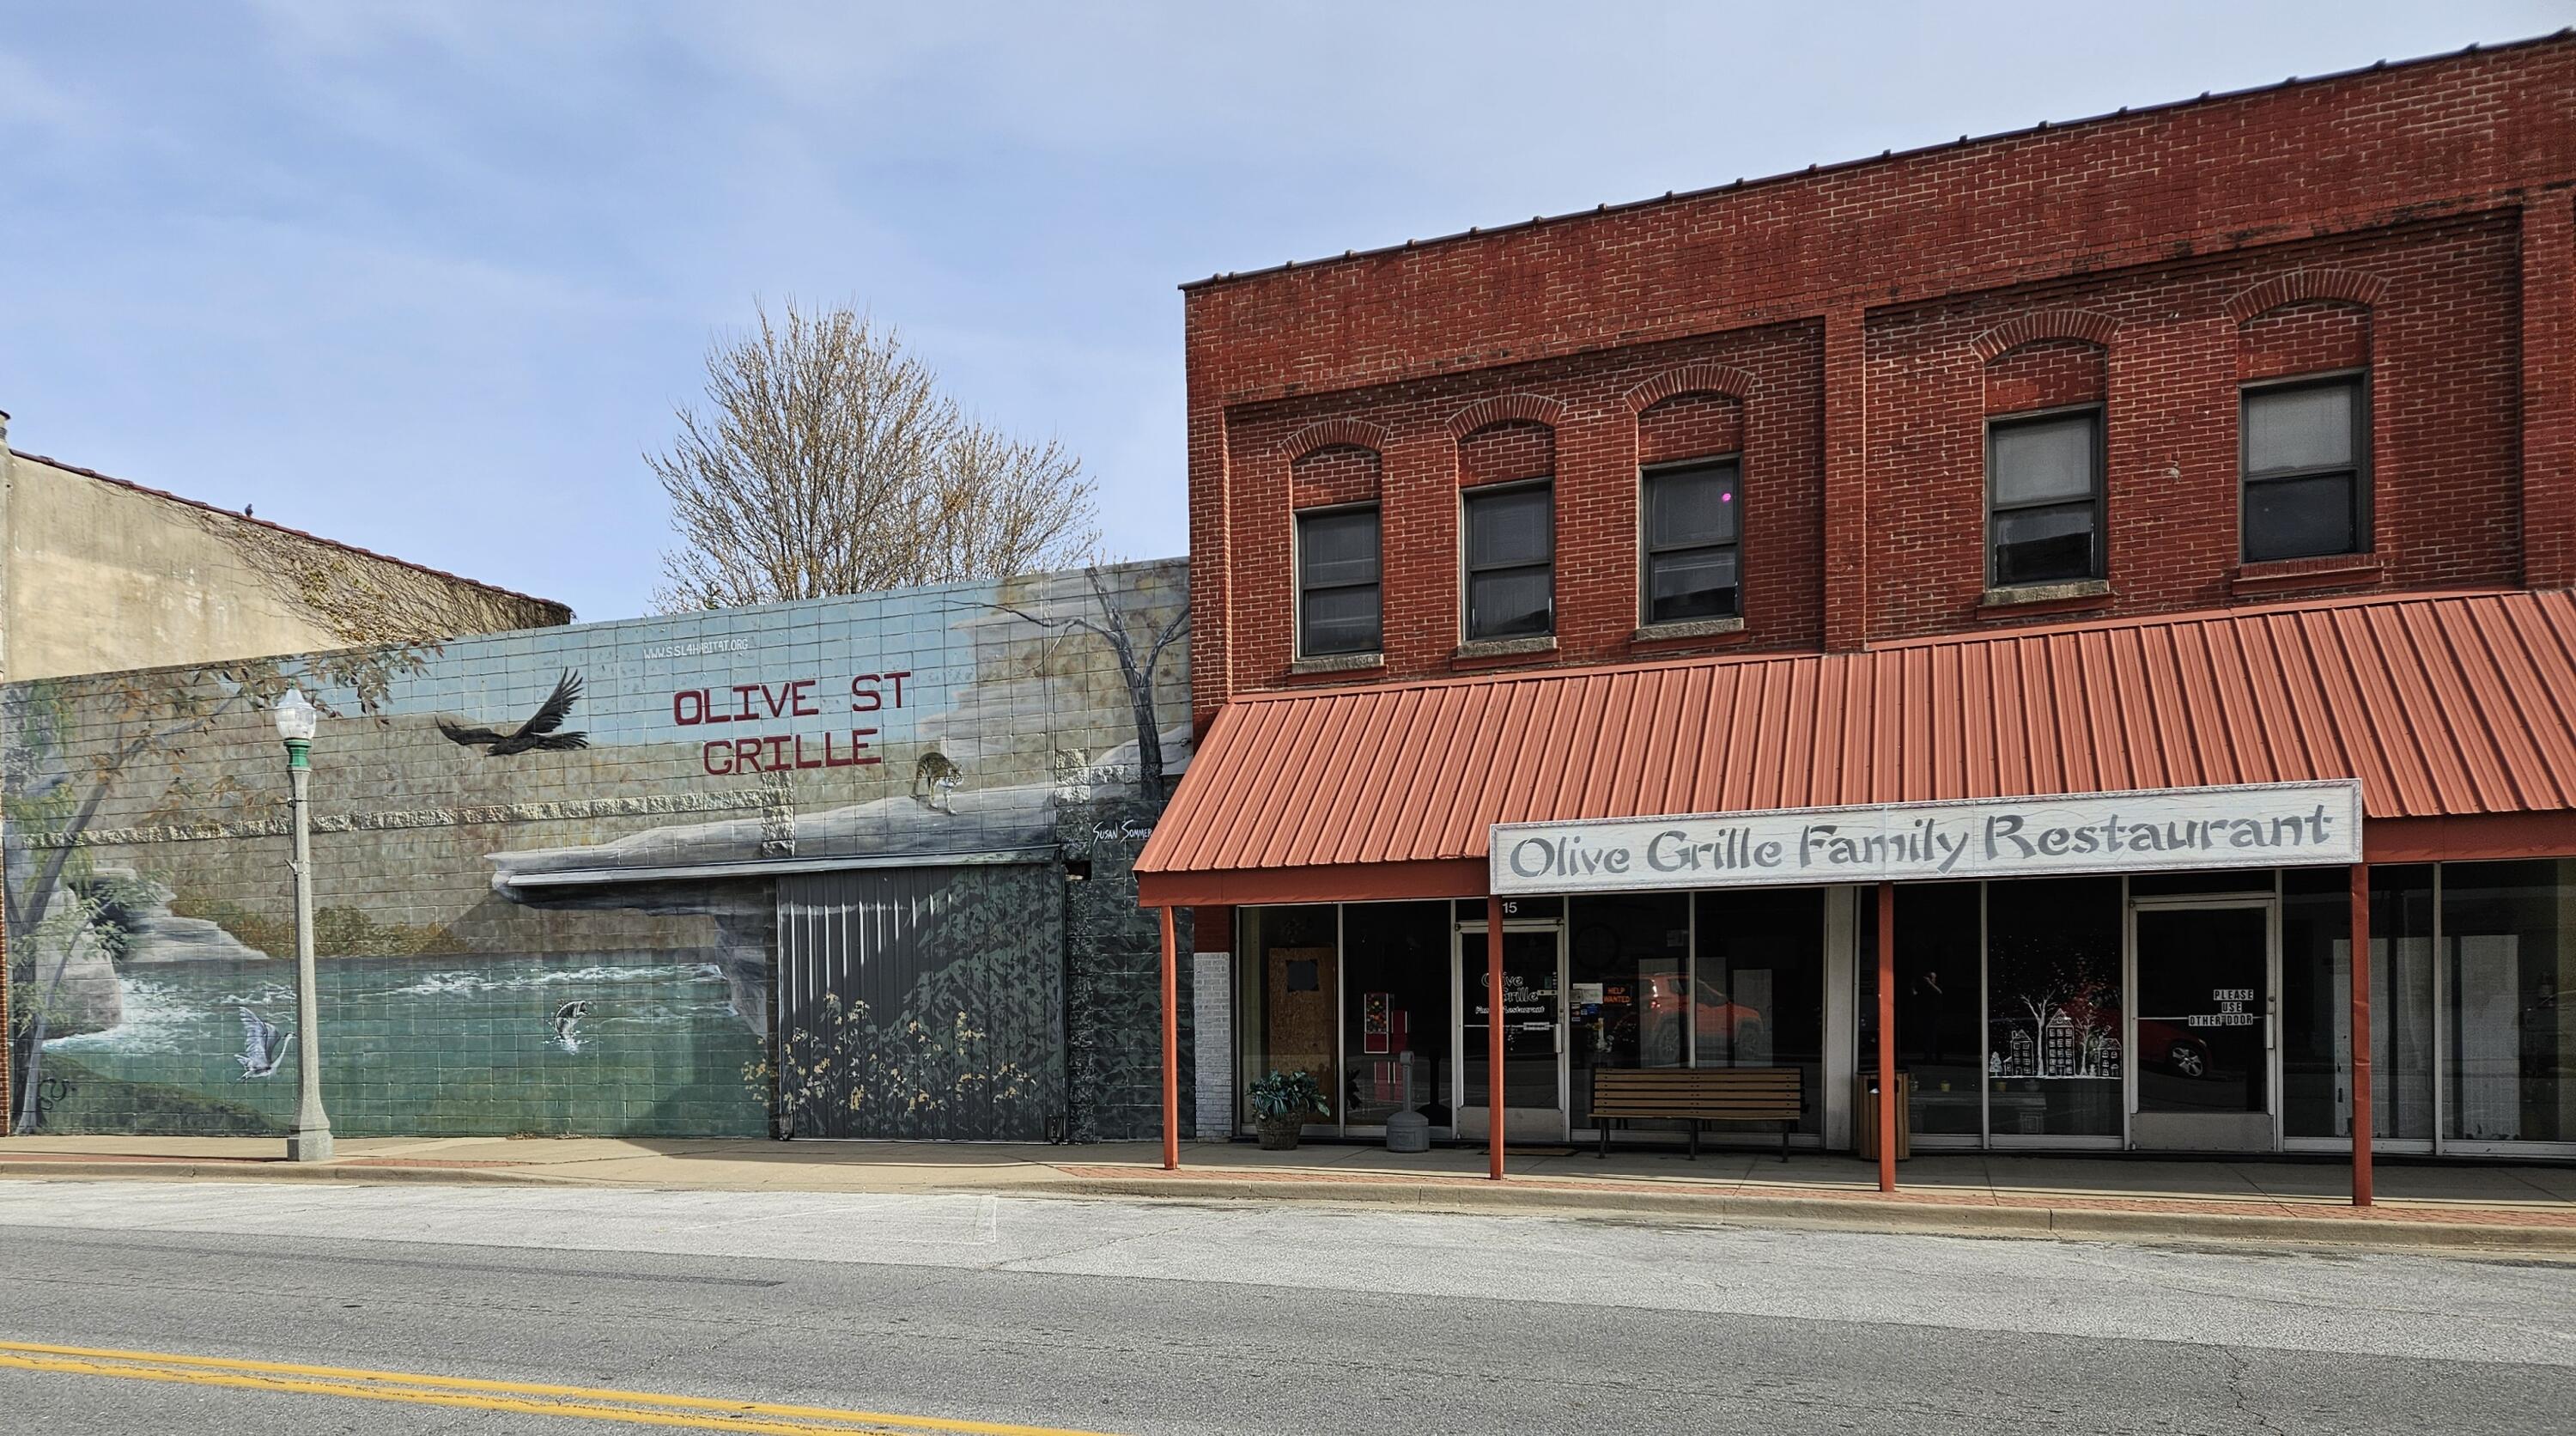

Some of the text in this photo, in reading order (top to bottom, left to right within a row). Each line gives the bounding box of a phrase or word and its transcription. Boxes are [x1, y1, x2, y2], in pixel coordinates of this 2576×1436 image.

[673, 671, 912, 726] OLIVE ST
[702, 728, 882, 776] GRILLE
[1510, 804, 2335, 878] Olive Grille Family Restaurant
[1607, 986, 1626, 995] HELP
[2215, 990, 2253, 1000] PLEASE
[1603, 995, 1631, 1004] WANTED
[2222, 1002, 2241, 1012] USE
[2190, 1014, 2252, 1025] OTHER DOOR
